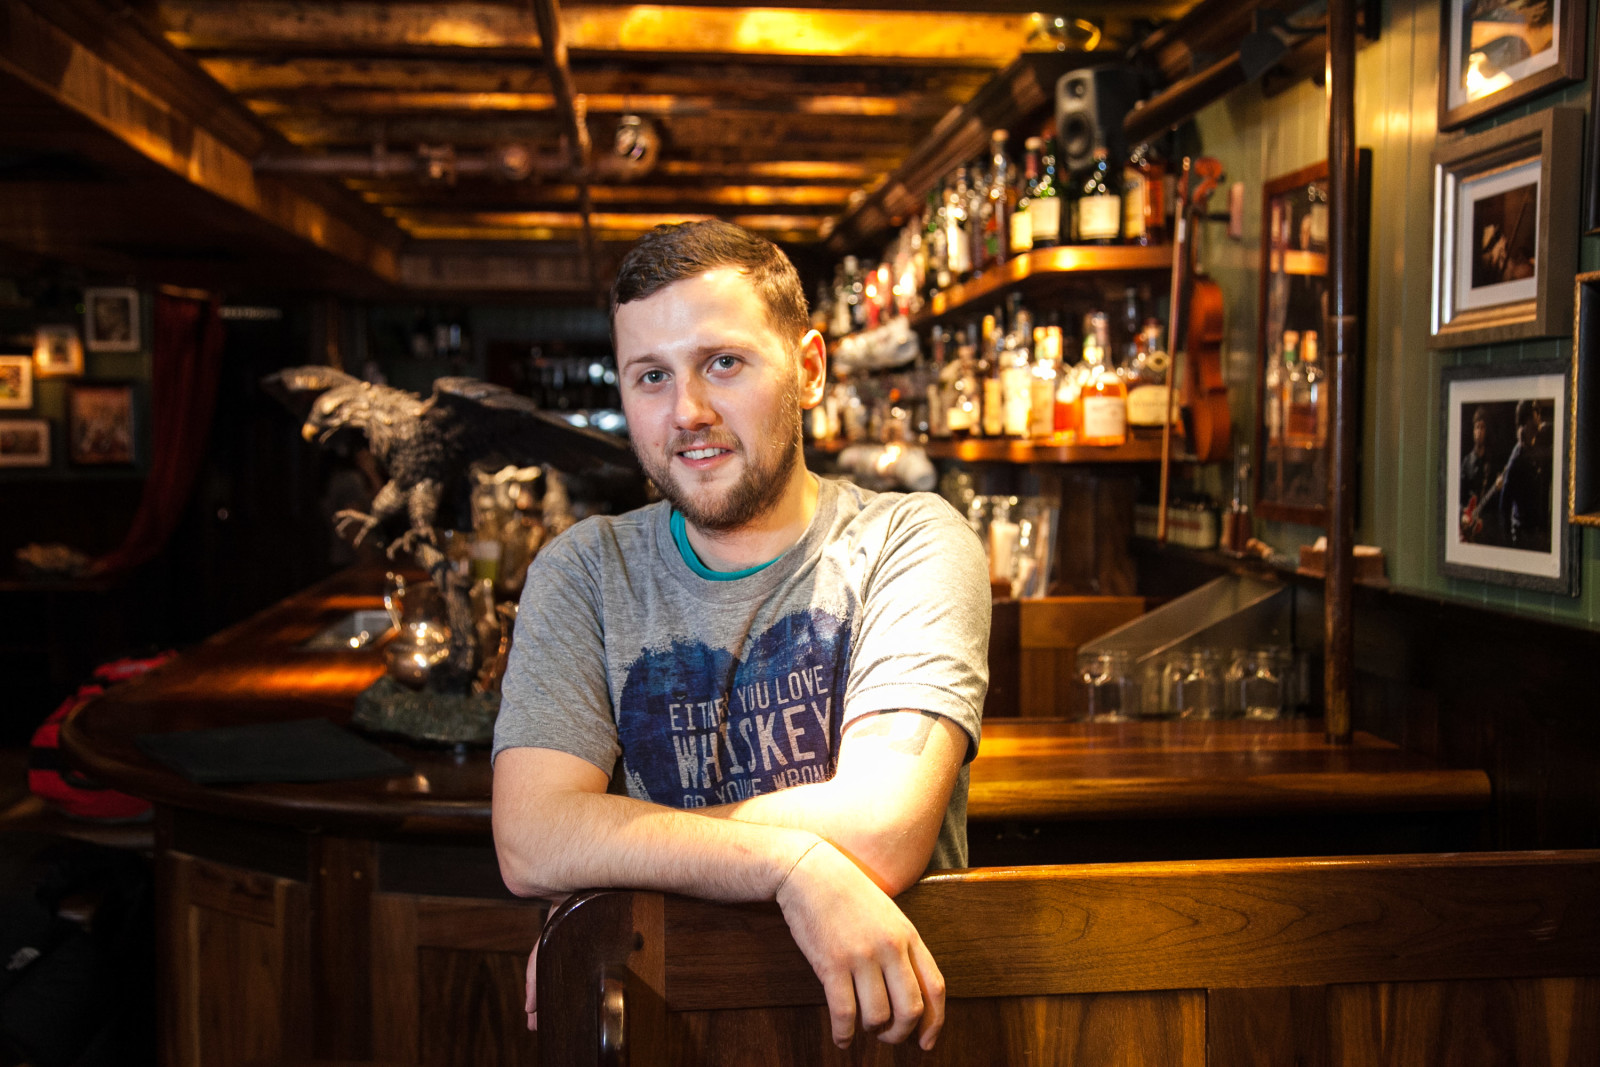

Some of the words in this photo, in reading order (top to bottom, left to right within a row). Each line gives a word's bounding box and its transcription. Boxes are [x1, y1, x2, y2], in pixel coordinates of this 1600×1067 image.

[737, 681, 770, 713] YOU
[775, 665, 829, 705] LOVE
[672, 696, 832, 789] WHISKEY
